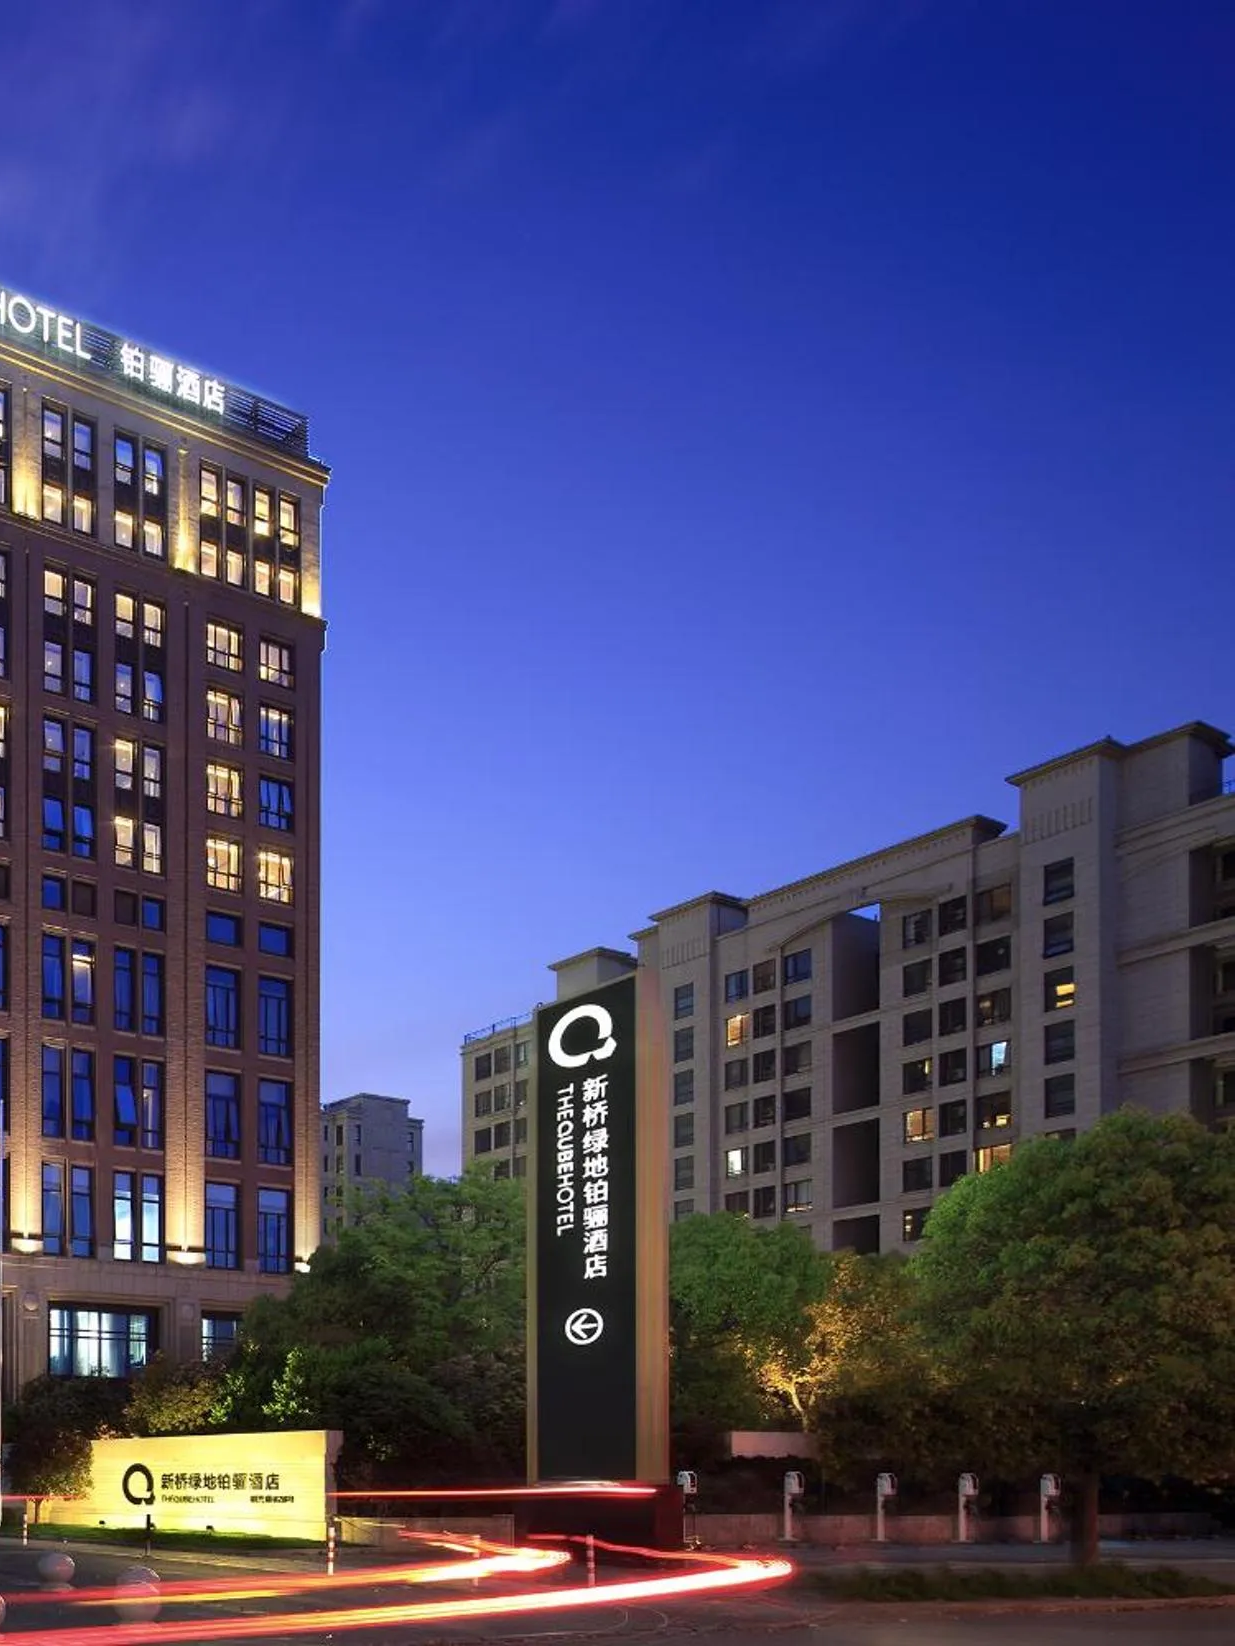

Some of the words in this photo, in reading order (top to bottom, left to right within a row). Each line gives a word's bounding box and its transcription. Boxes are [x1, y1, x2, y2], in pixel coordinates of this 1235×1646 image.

[582, 1073, 609, 1280] 新桥绿地铂骊酒店
